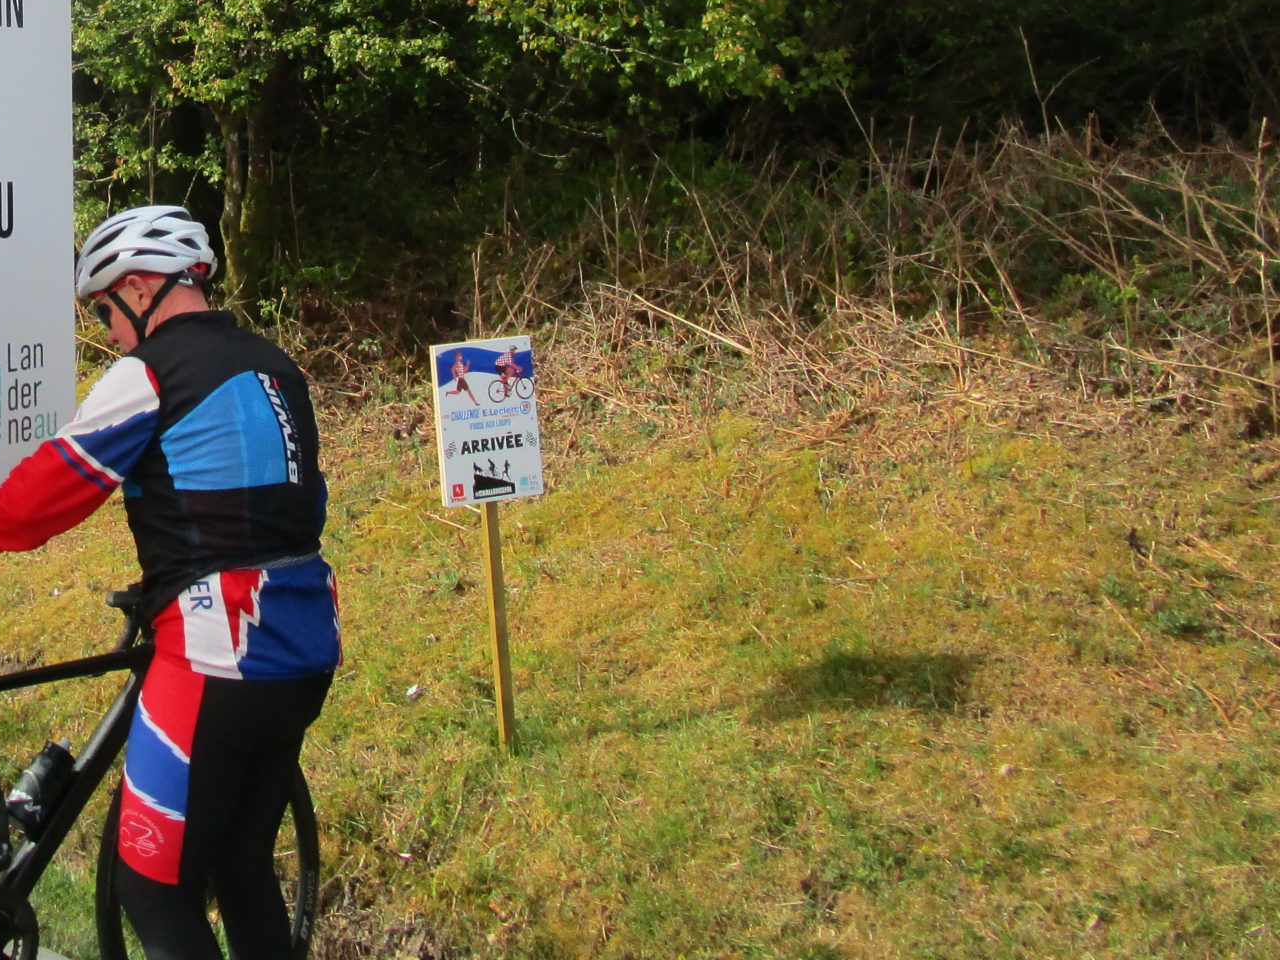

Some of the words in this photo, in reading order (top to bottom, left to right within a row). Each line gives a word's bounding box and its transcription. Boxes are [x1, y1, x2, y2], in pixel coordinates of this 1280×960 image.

[7, 343, 44, 373] Lan
[7, 378, 42, 411] der
[8, 411, 57, 445] neau
[460, 431, 524, 456] ARRIVÉE
